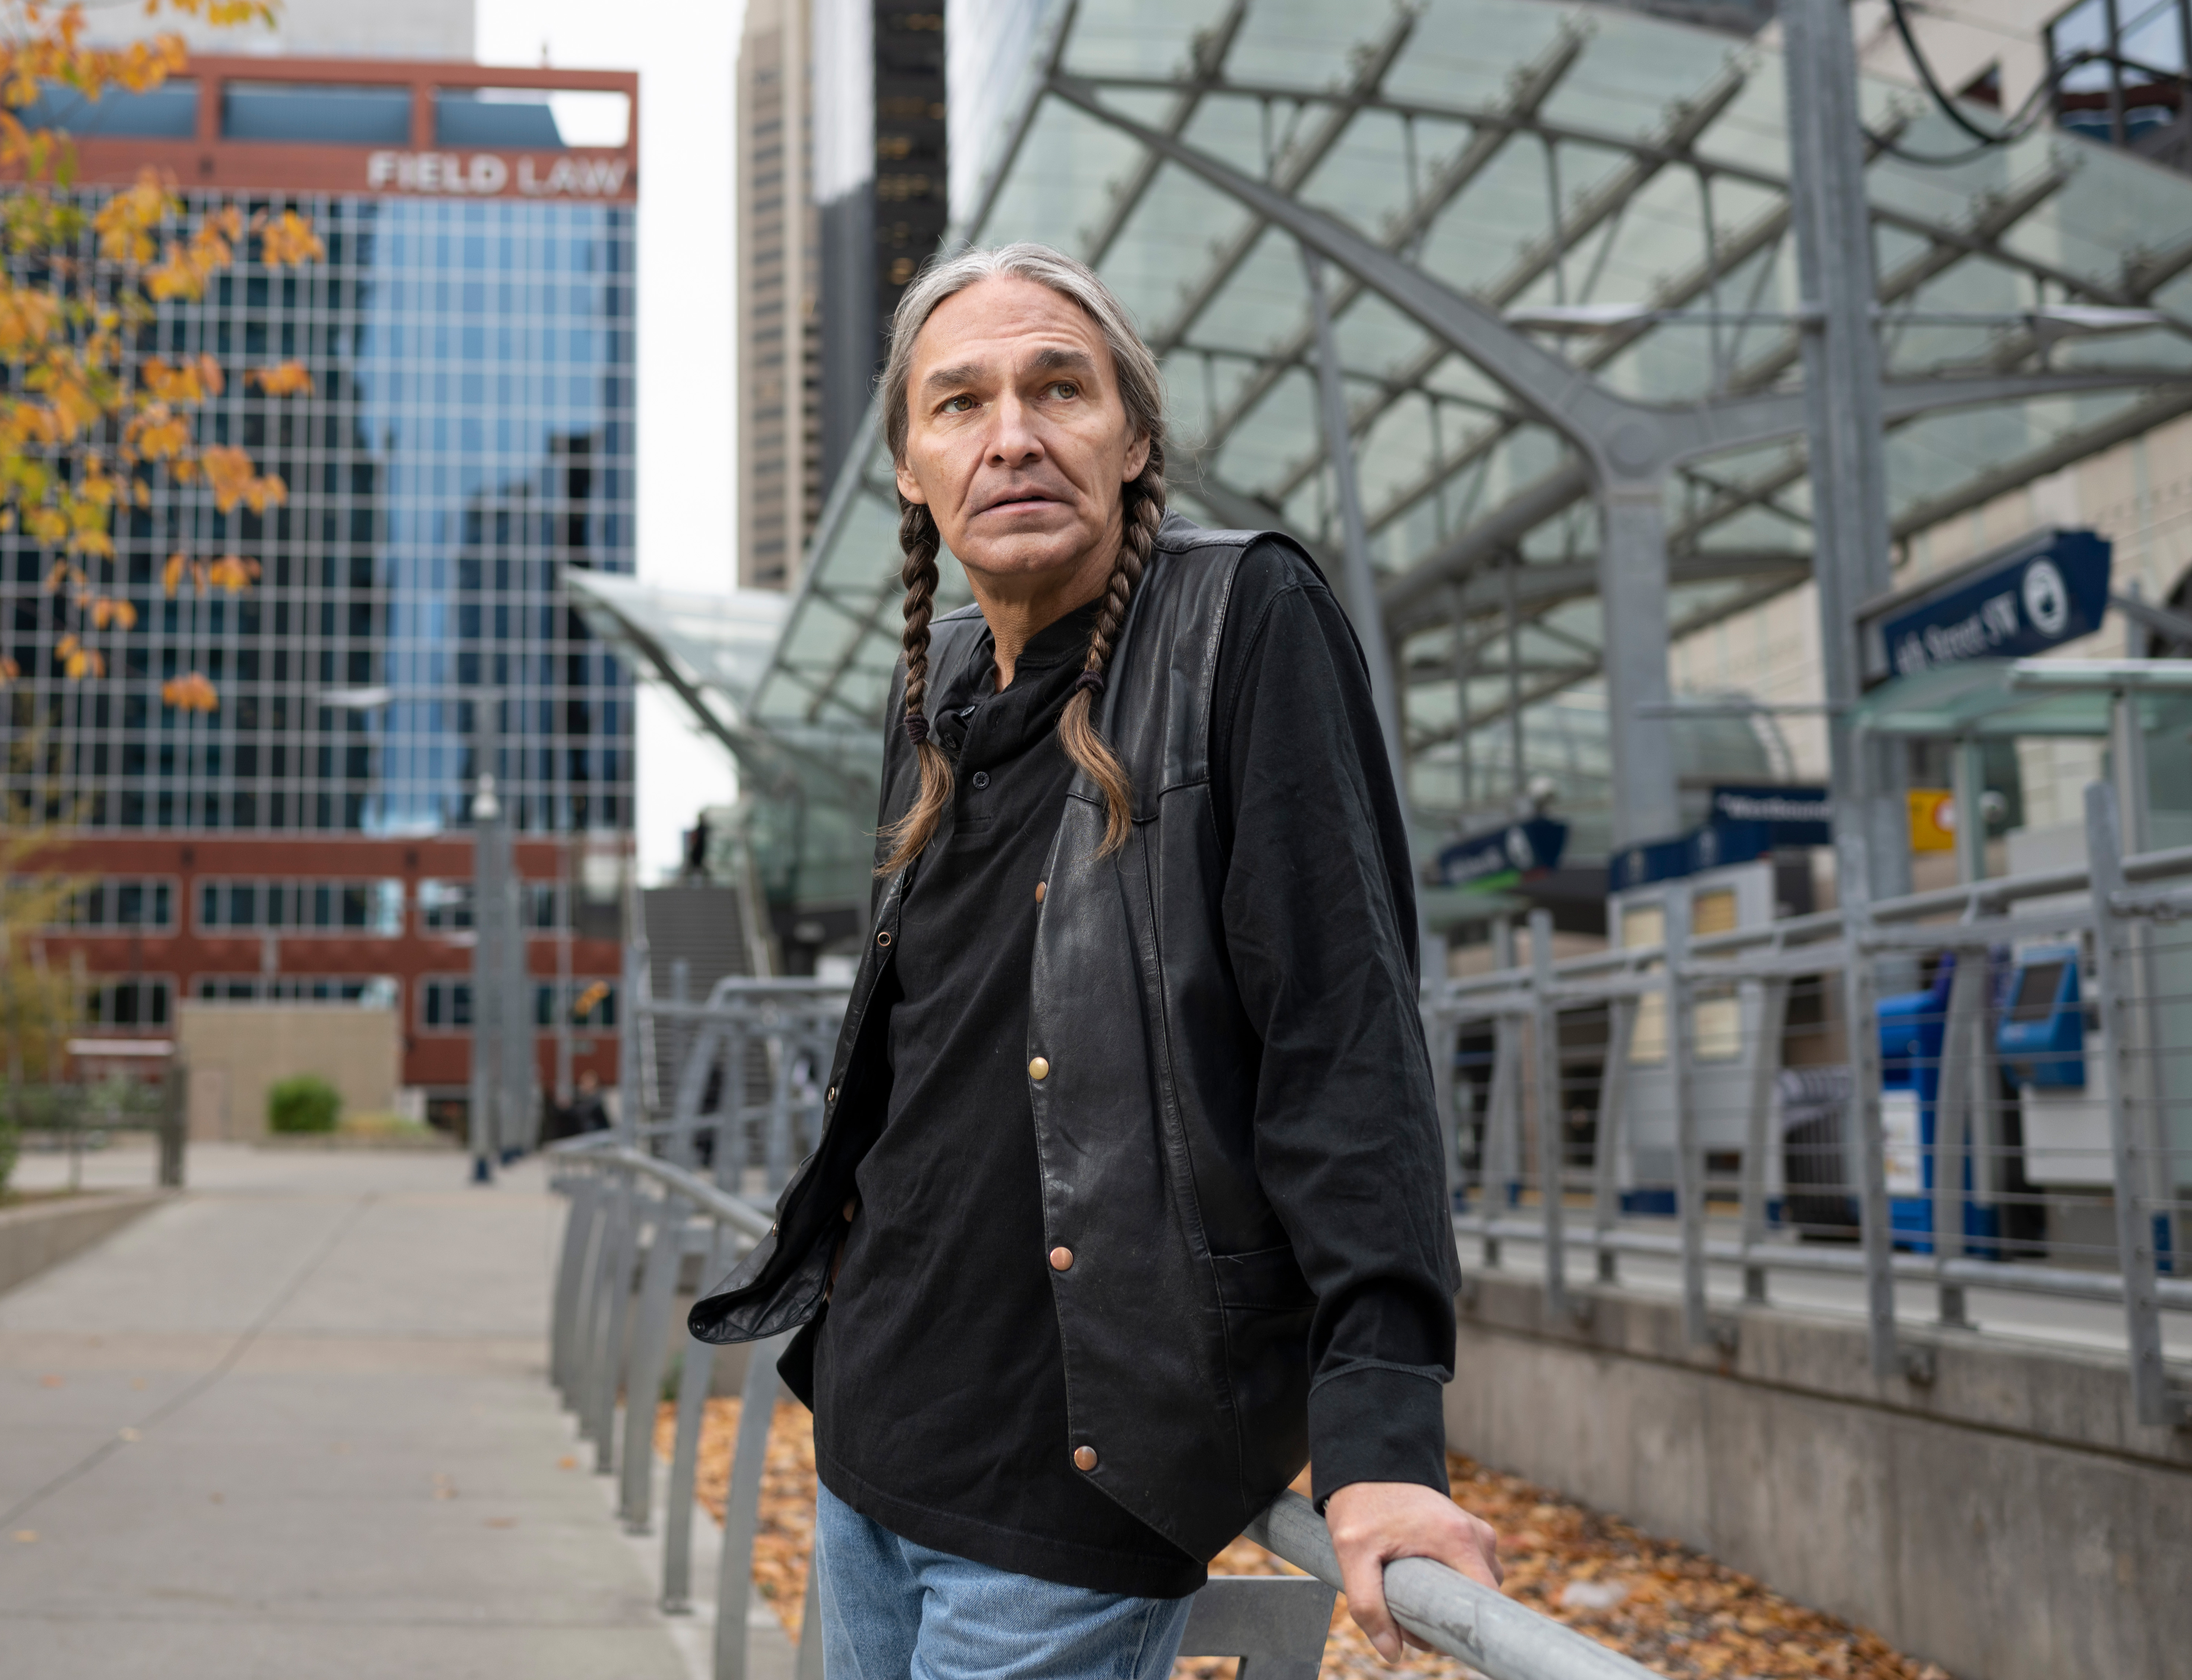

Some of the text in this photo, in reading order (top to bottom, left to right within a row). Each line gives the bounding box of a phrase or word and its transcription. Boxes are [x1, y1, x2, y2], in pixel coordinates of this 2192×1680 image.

[369, 150, 628, 196] FIELD LAW
[1924, 614, 1986, 662] Street
[1981, 590, 2018, 647] SW
